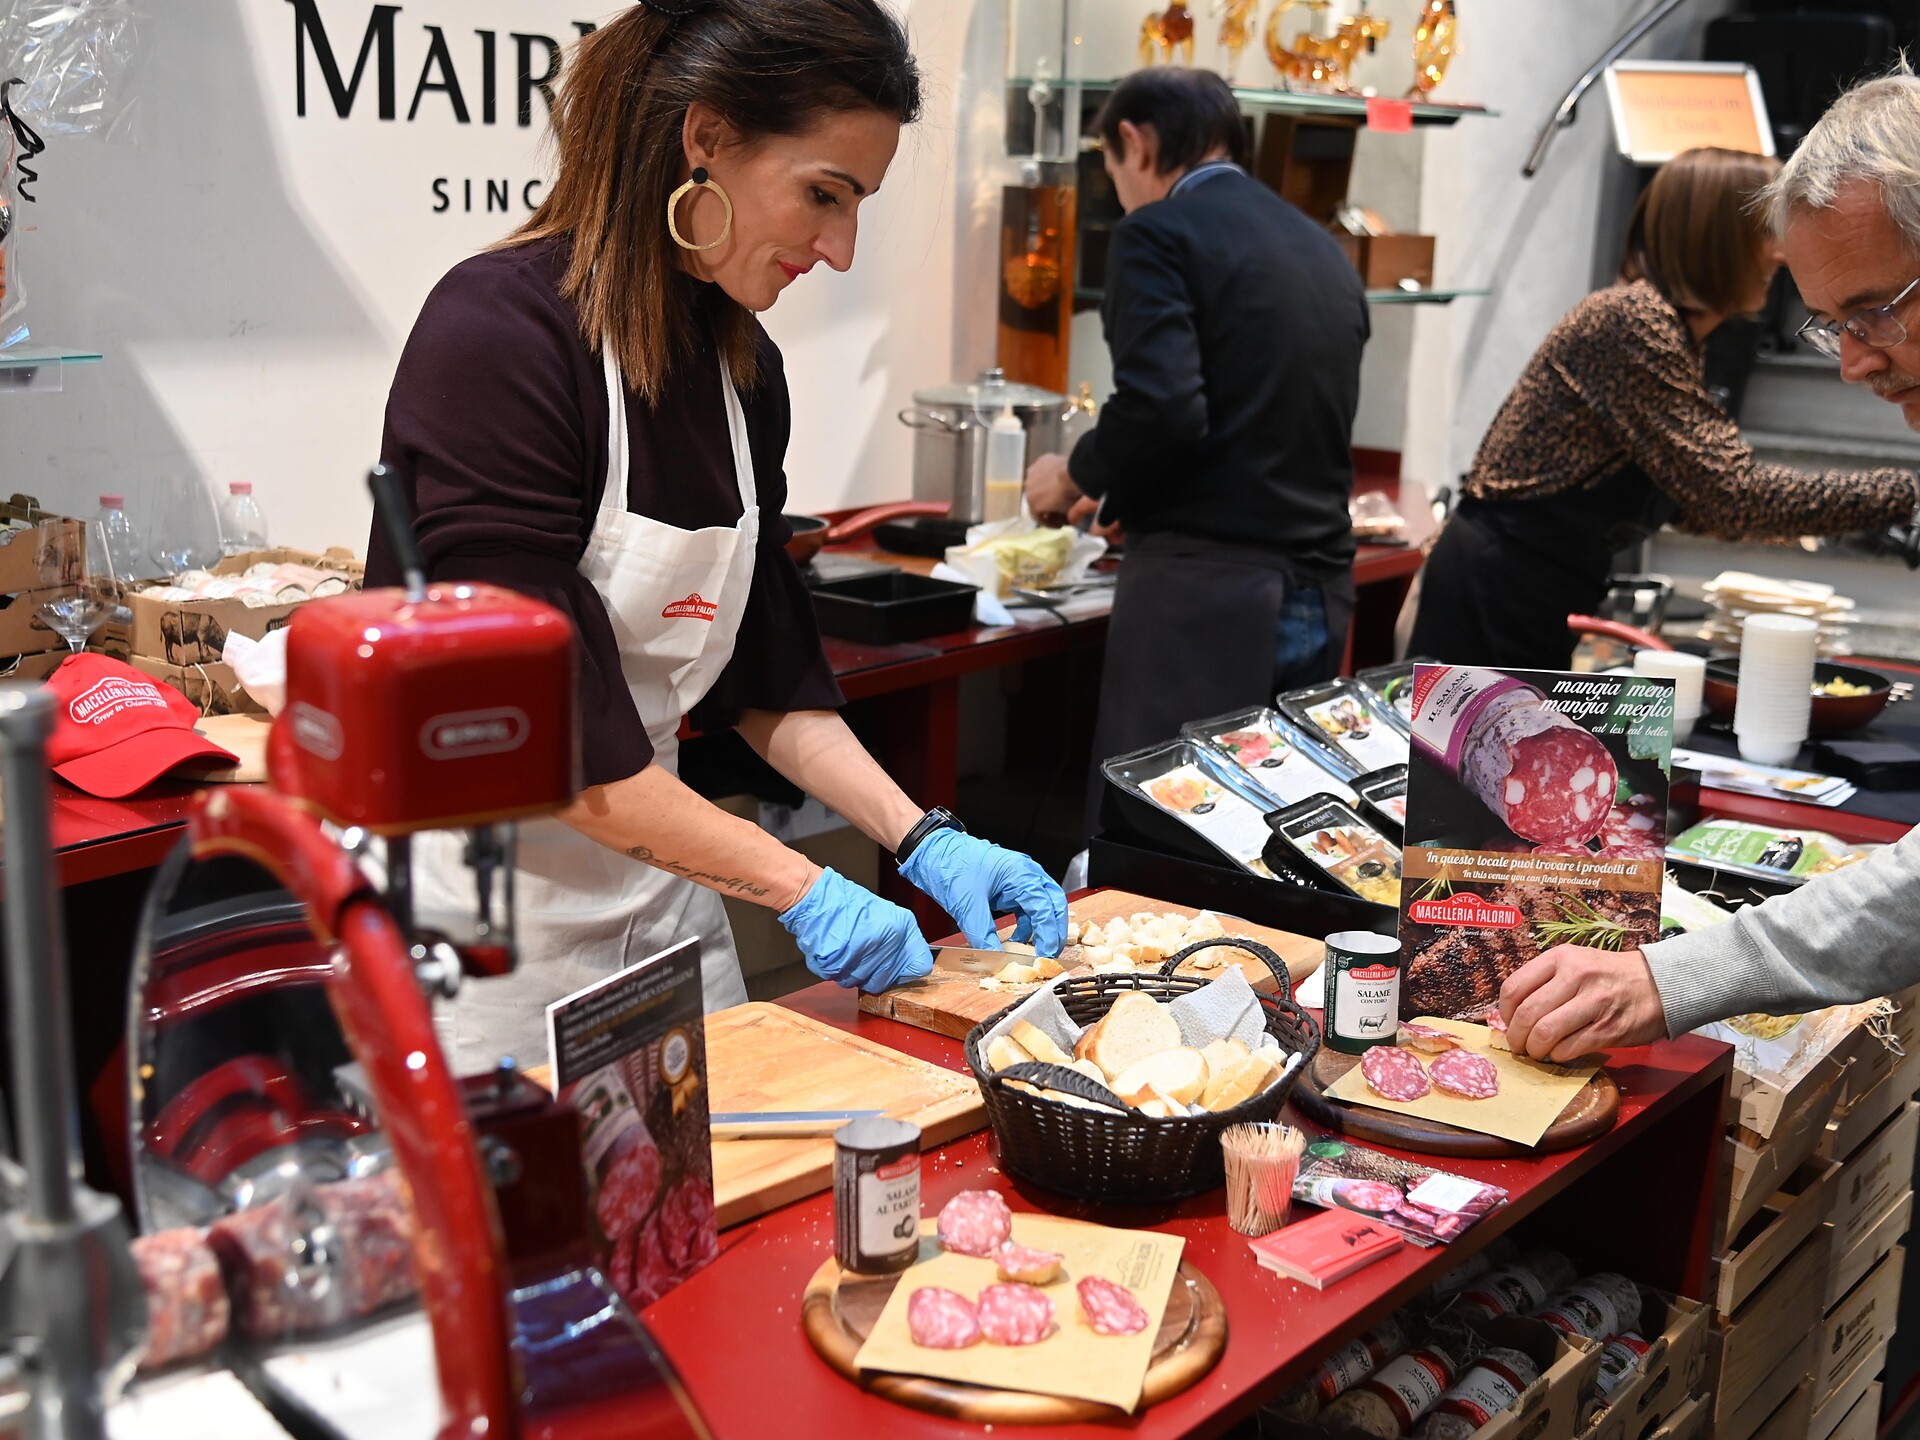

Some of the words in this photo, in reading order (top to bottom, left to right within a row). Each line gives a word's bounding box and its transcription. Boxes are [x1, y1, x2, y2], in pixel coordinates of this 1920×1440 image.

[285, 0, 598, 127] MAIR
[432, 178, 542, 213] SINC
[1435, 671, 1471, 706] SALAME
[1552, 677, 1622, 701] mangia
[1626, 684, 1674, 699] meno
[75, 687, 133, 718] MACELLERIA
[93, 709, 114, 725] Greve
[115, 702, 124, 713] in
[1537, 697, 1609, 720] mangia
[1613, 697, 1673, 723] meglio
[1591, 723, 1608, 733] eat
[1609, 723, 1624, 734] less
[1627, 726, 1643, 735] eat
[1645, 726, 1668, 737] better
[1302, 810, 1334, 829] GOURMET
[1426, 851, 1438, 863] In
[1439, 854, 1474, 869] questo
[1477, 855, 1508, 868] locale
[1510, 857, 1534, 870] puoi
[1535, 859, 1575, 872] trovare
[1581, 862, 1625, 876] prodotti
[1625, 864, 1638, 875] di
[1462, 869, 1472, 878] In
[1473, 870, 1487, 879] this
[1487, 872, 1510, 881] venue
[1510, 874, 1526, 884] you
[1526, 875, 1541, 883] can
[1540, 874, 1558, 886] find
[1557, 876, 1592, 886] products
[1592, 877, 1602, 888] of
[1451, 897, 1481, 908] ANTICA
[1416, 905, 1473, 922] MACELLERIA
[1476, 909, 1515, 924] FALORNI
[1352, 970, 1381, 978] MACELLERIA
[1357, 989, 1391, 998] SALAME
